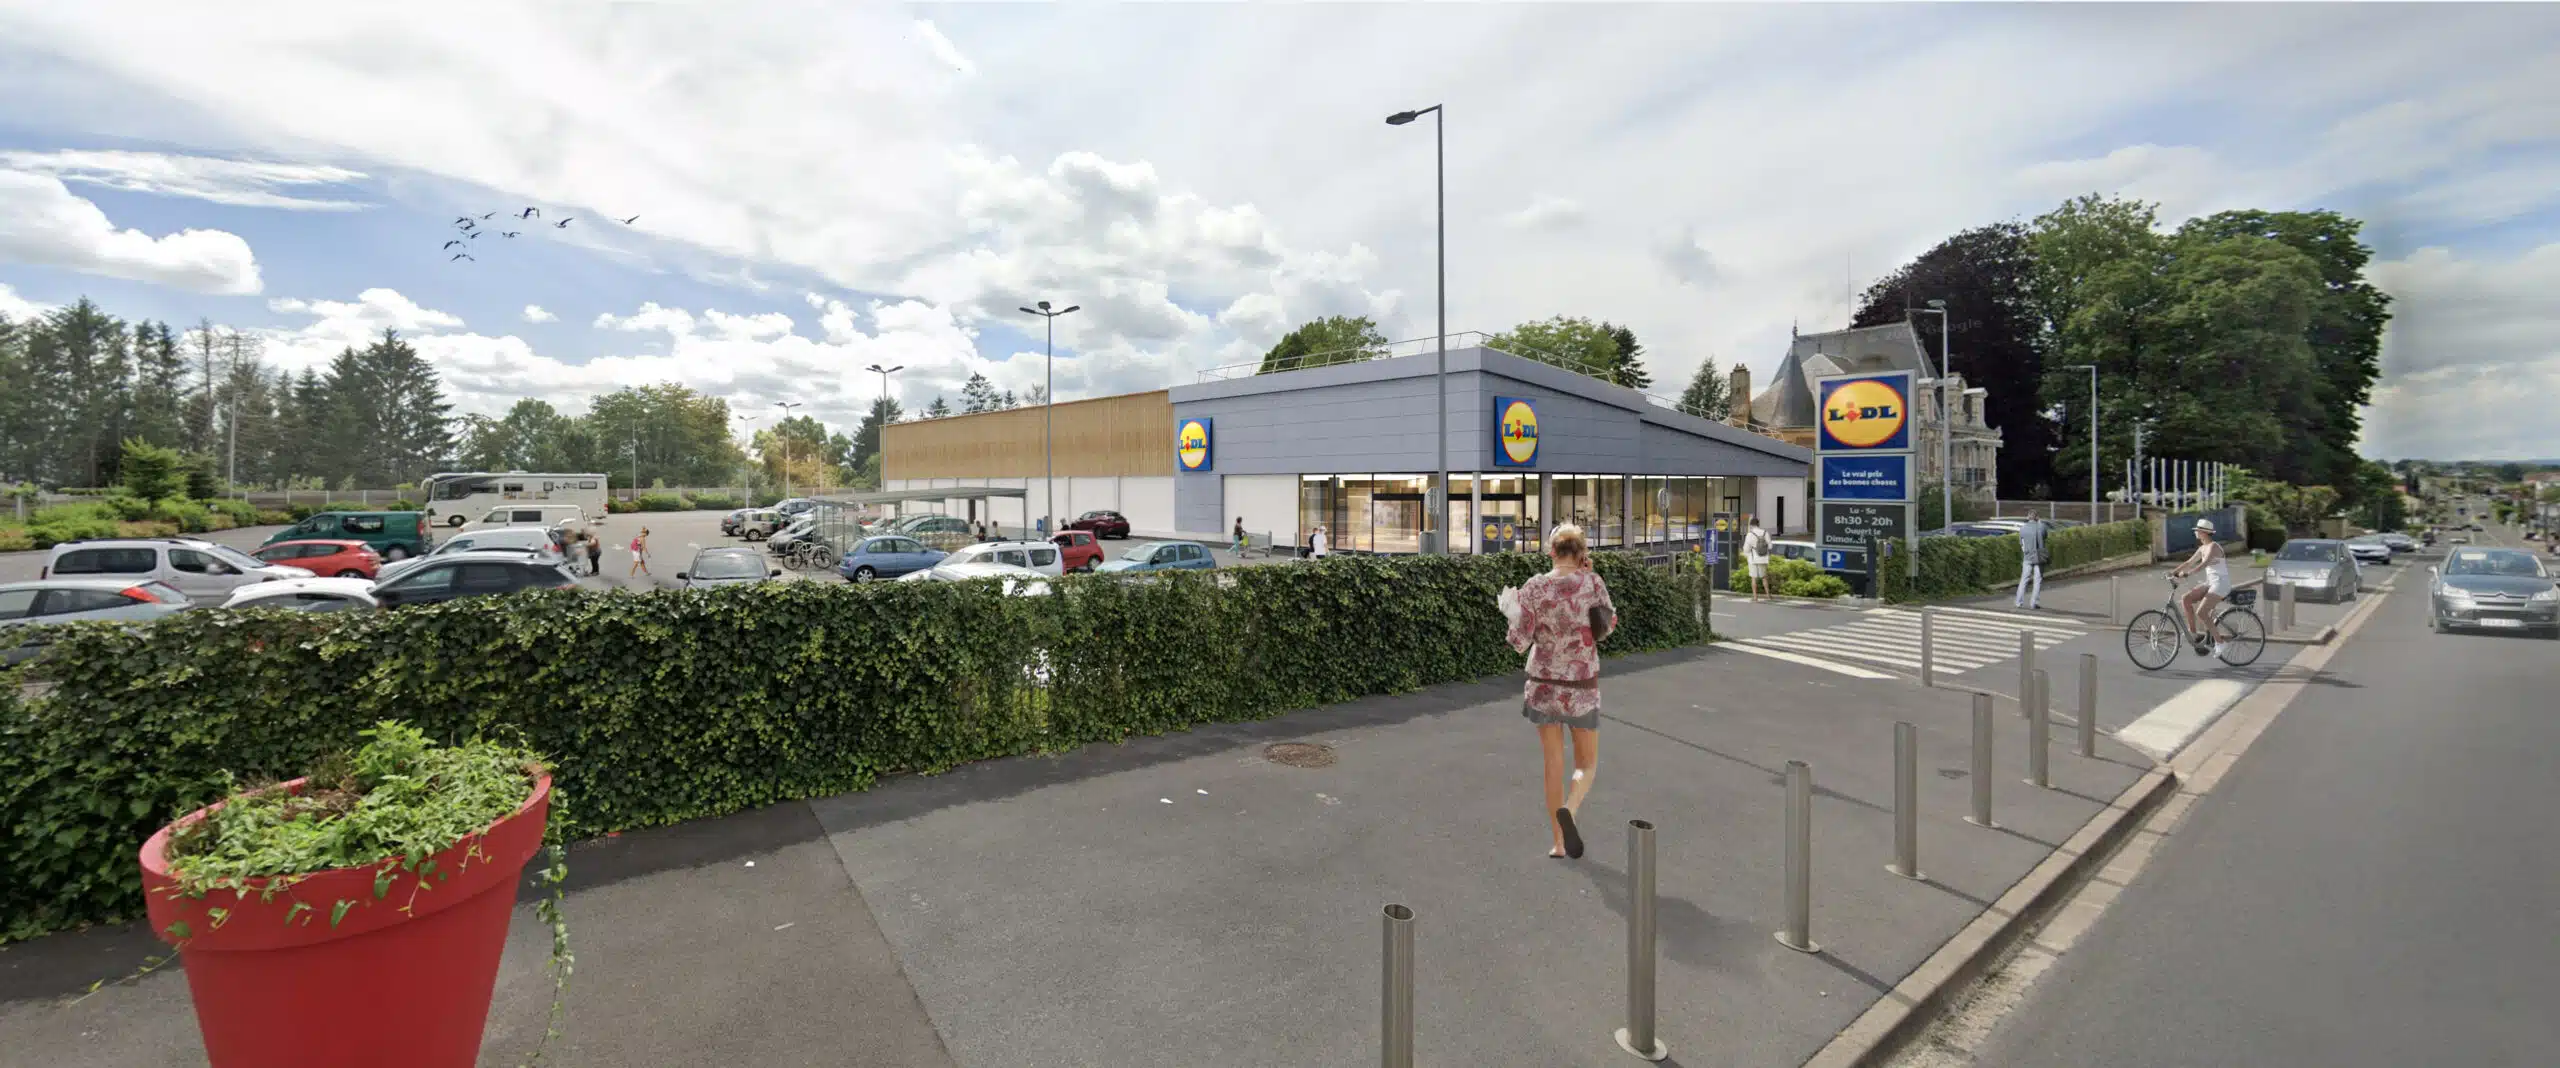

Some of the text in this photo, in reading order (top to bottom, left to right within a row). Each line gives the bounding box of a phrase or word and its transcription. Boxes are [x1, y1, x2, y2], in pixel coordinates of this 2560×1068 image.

[1852, 470, 1866, 478] vrai
[1867, 470, 1883, 479] prix
[1834, 515, 1862, 525] 8h30
[1871, 516, 1893, 526] 20h
[1827, 551, 1842, 567] P
